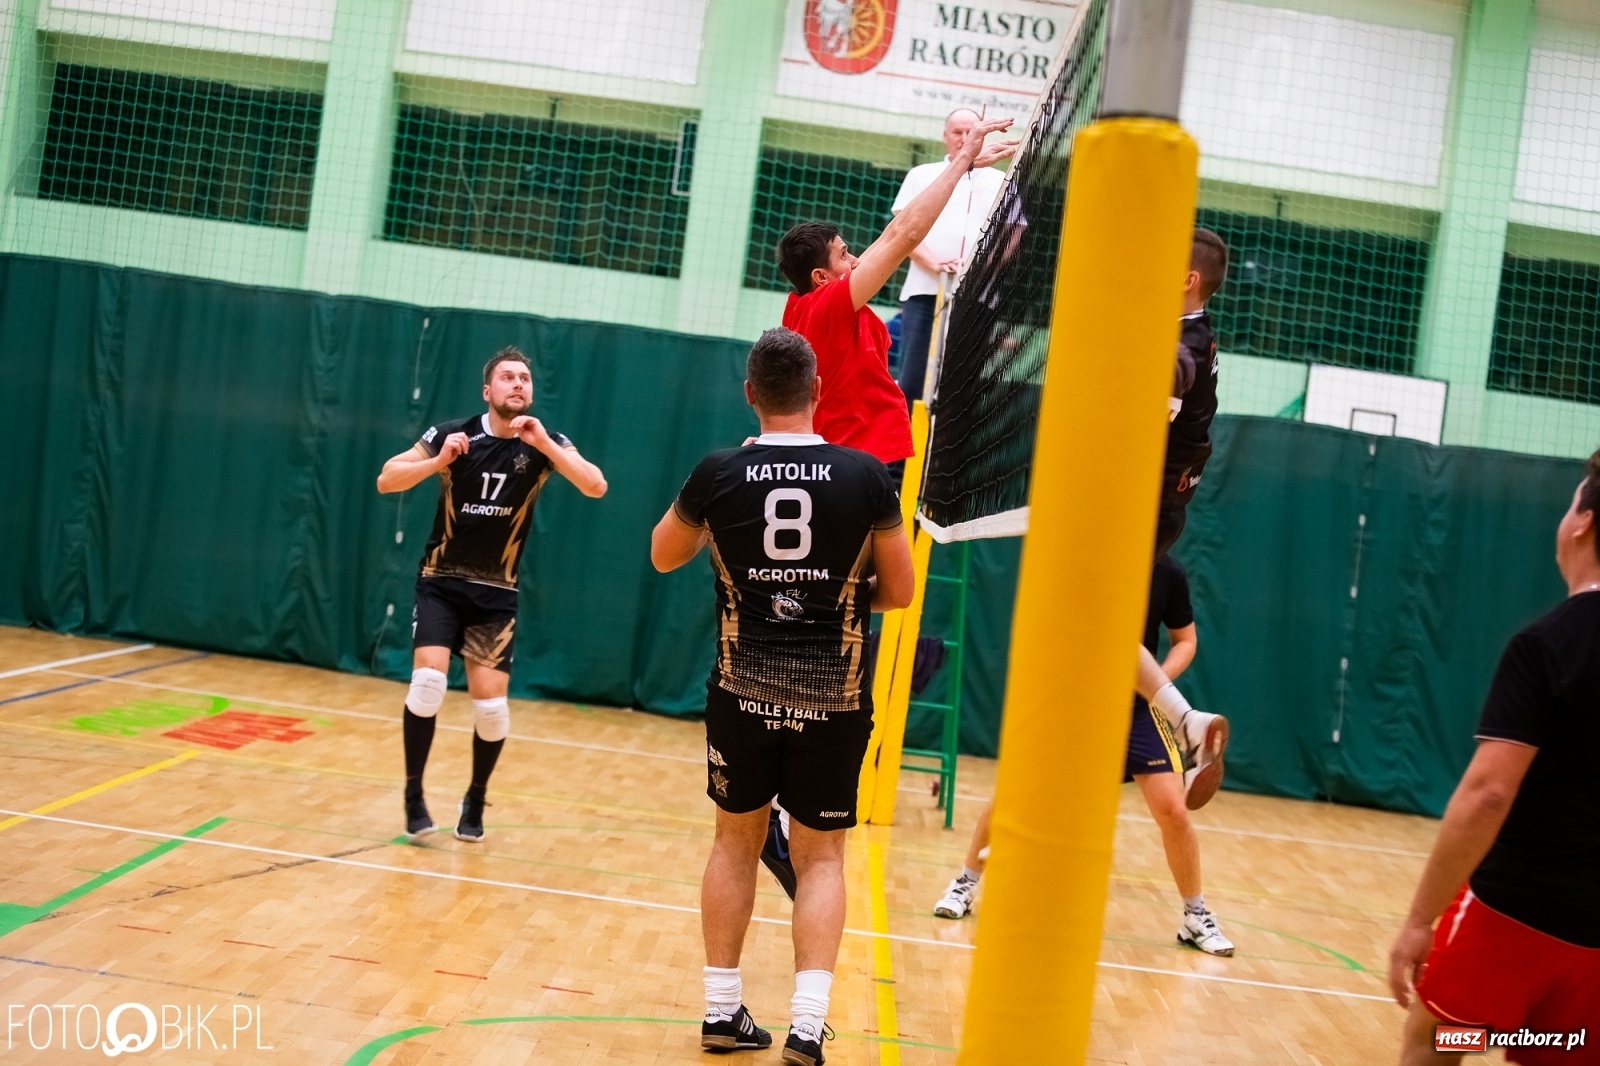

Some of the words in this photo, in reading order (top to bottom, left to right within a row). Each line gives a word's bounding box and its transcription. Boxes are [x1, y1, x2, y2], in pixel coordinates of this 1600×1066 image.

[935, 4, 1056, 43] MIASTO
[745, 463, 832, 482] KATOLIK
[480, 471, 507, 501] 17
[461, 502, 513, 517] AGROTIM
[763, 487, 813, 561] 8
[748, 567, 830, 583] AGROTIM
[738, 698, 829, 721] VOLLEYBALL
[764, 719, 804, 733] TEAM
